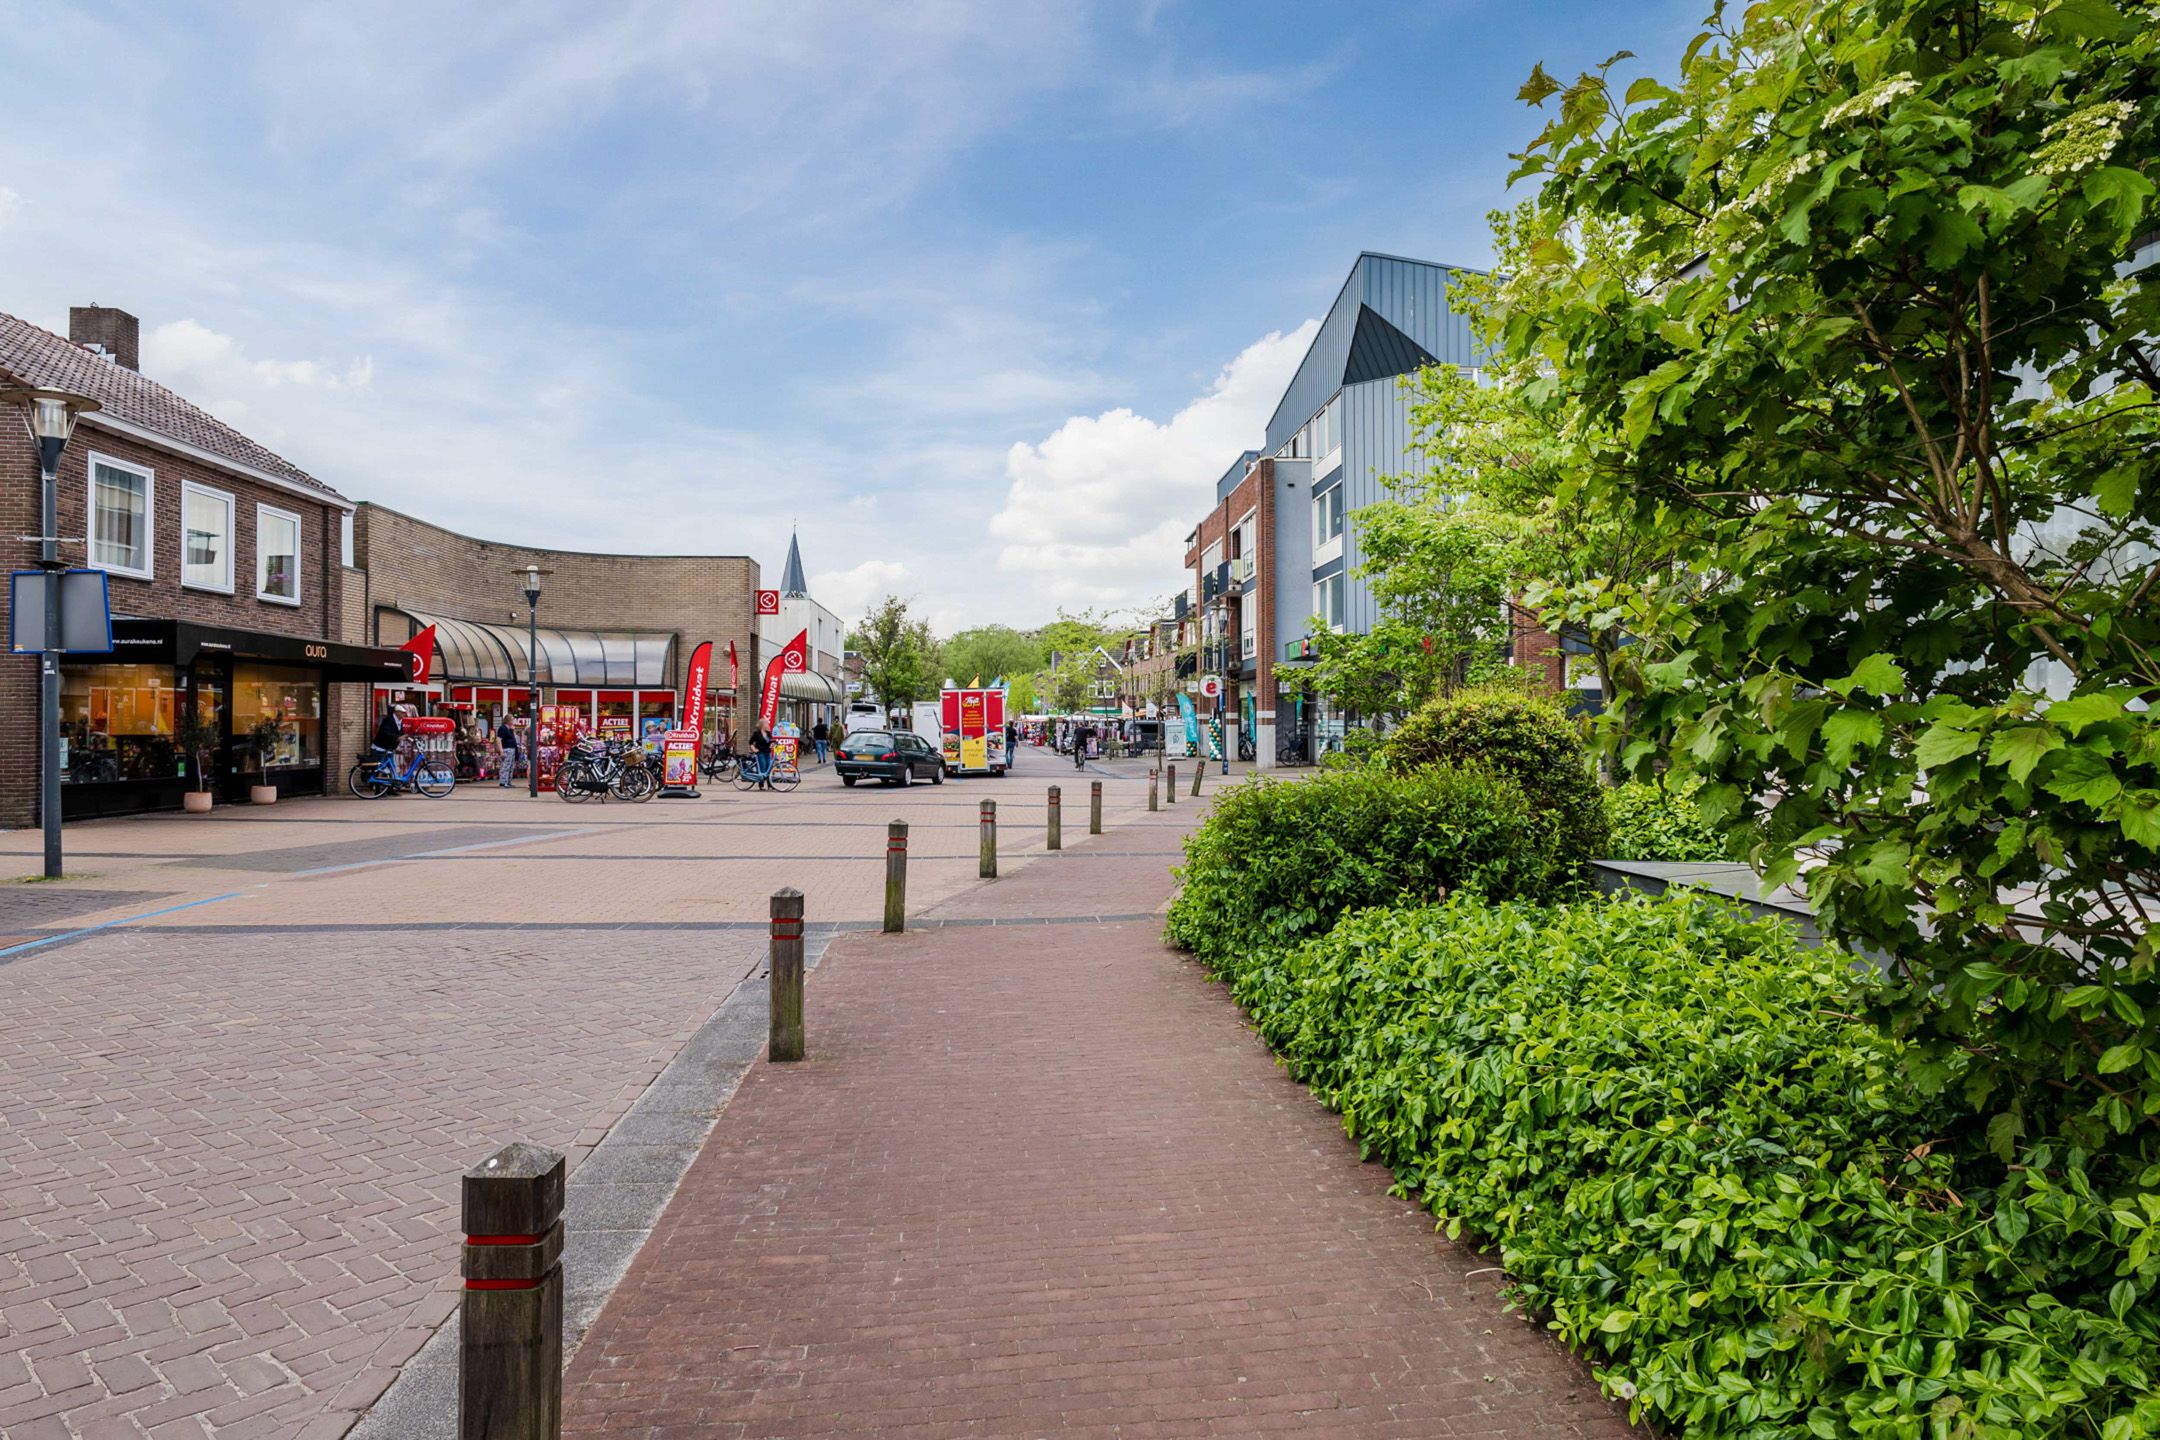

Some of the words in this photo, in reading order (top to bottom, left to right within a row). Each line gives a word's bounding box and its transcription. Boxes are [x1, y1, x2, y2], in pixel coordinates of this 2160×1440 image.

[305, 645, 327, 658] aura
[690, 666, 704, 726] Kruidvat
[602, 718, 629, 726] ACTIE!
